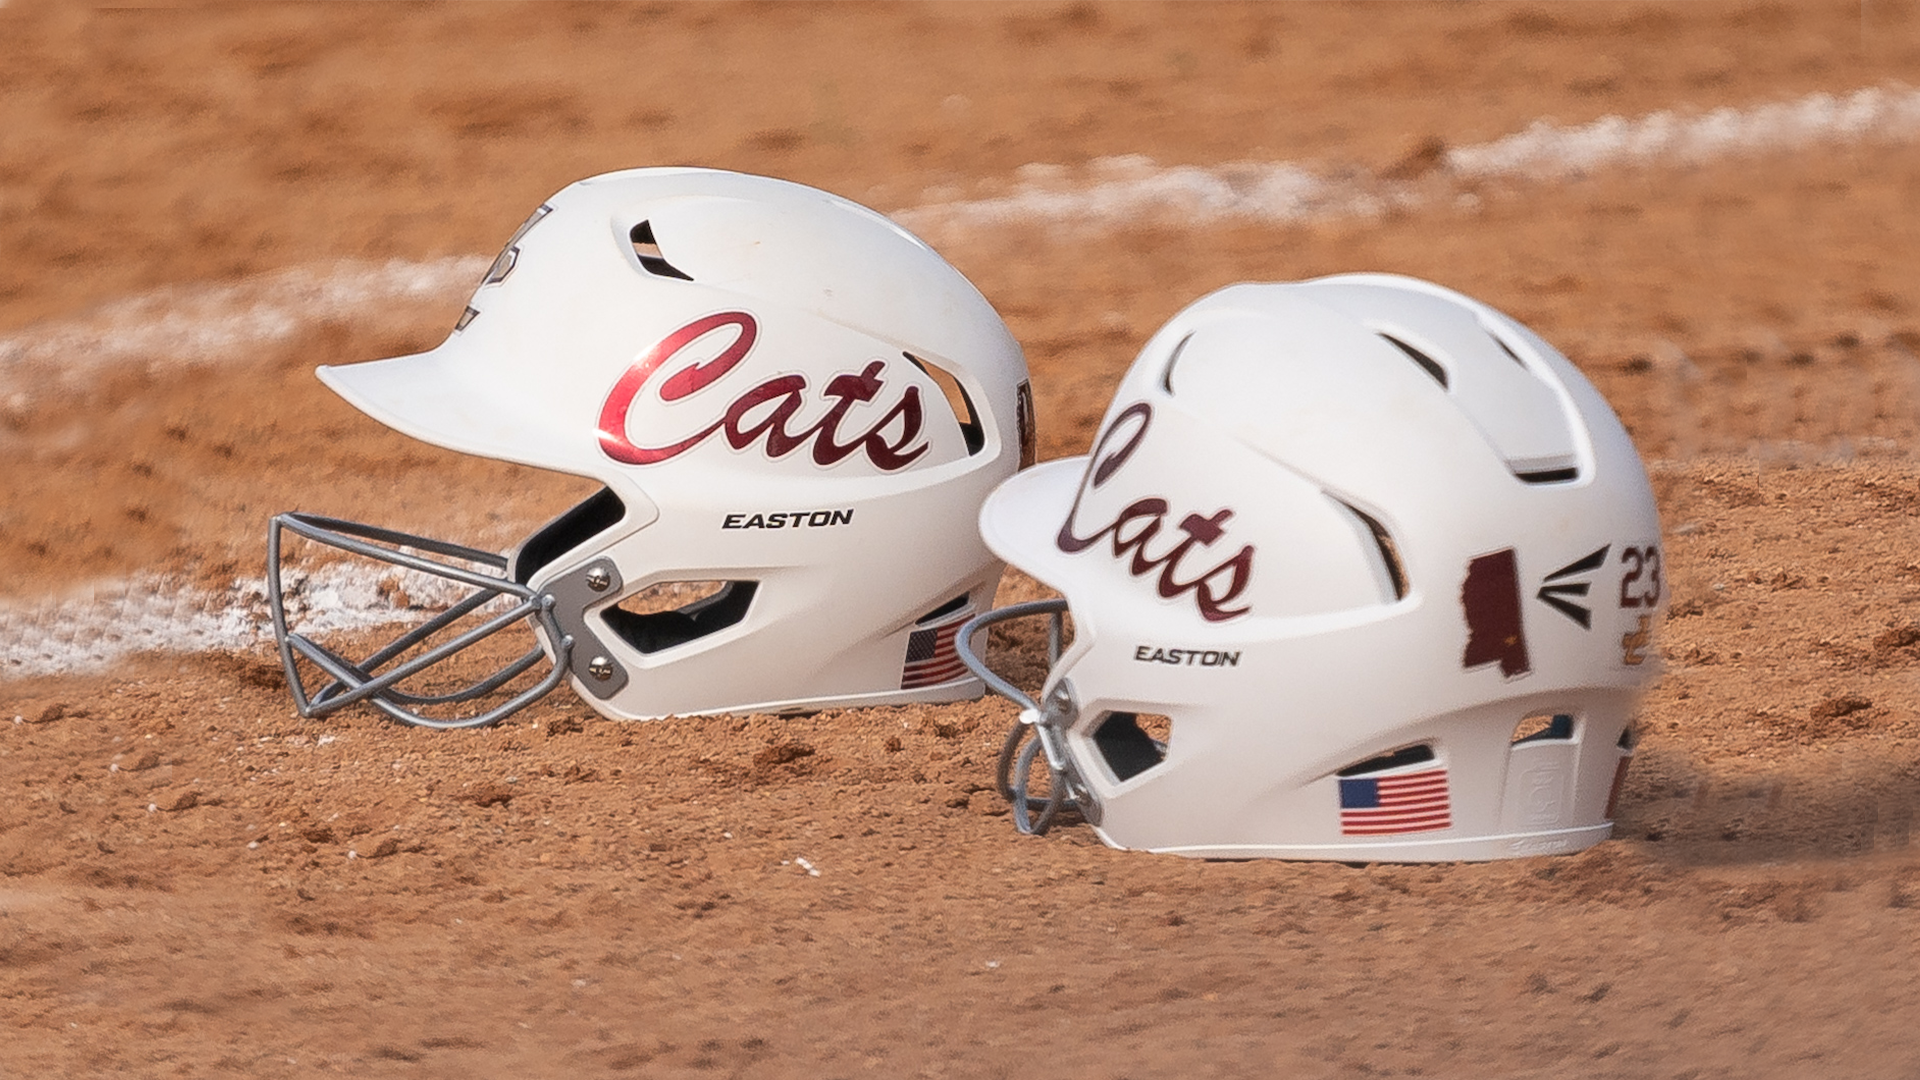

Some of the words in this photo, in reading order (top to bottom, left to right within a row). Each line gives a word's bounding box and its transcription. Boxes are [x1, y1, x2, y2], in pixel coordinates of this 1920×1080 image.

[598, 310, 930, 471] Cats
[721, 508, 854, 530] EASTON
[1056, 402, 1255, 623] Cats
[1620, 546, 1661, 608] 23
[1134, 645, 1241, 667] EASTON
